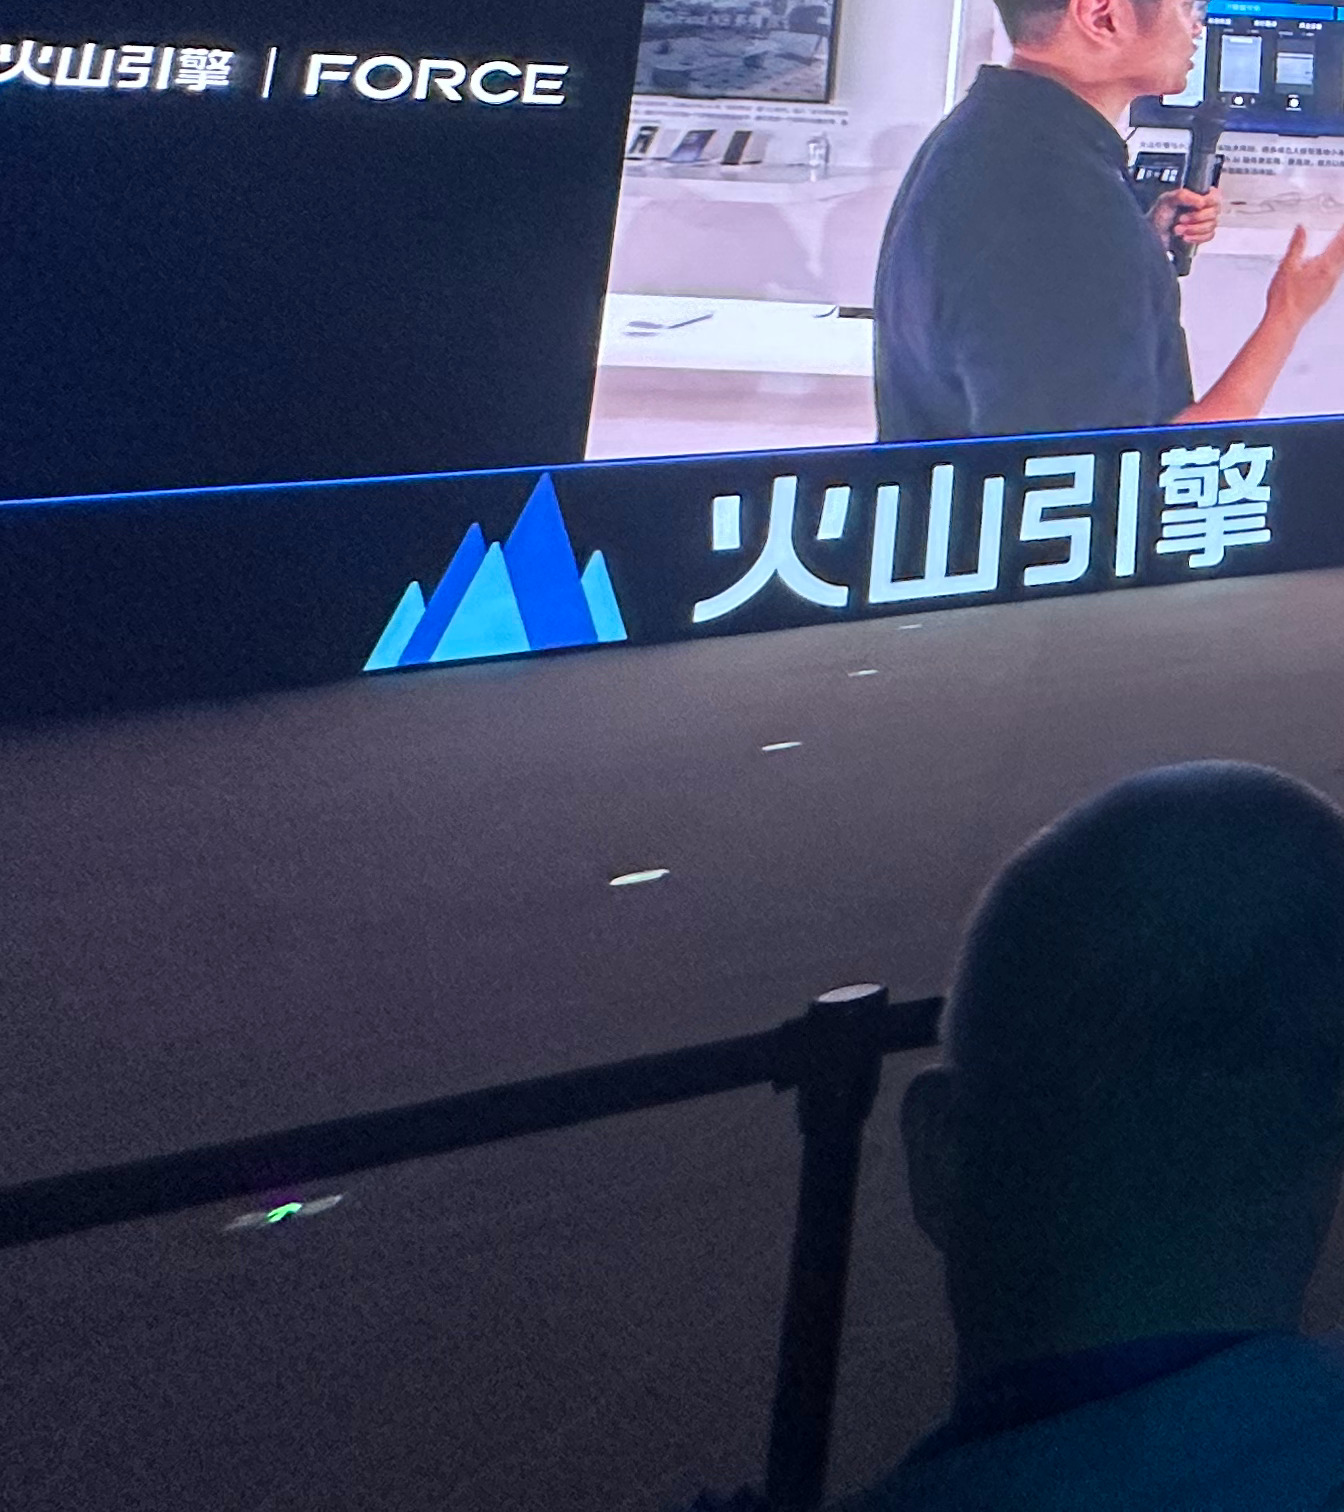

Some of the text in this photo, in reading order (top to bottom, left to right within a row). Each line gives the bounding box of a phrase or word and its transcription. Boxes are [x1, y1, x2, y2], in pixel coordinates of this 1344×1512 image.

[0, 39, 569, 106] 火山引擎 FORCE
[692, 442, 1274, 623] 火山引擎
